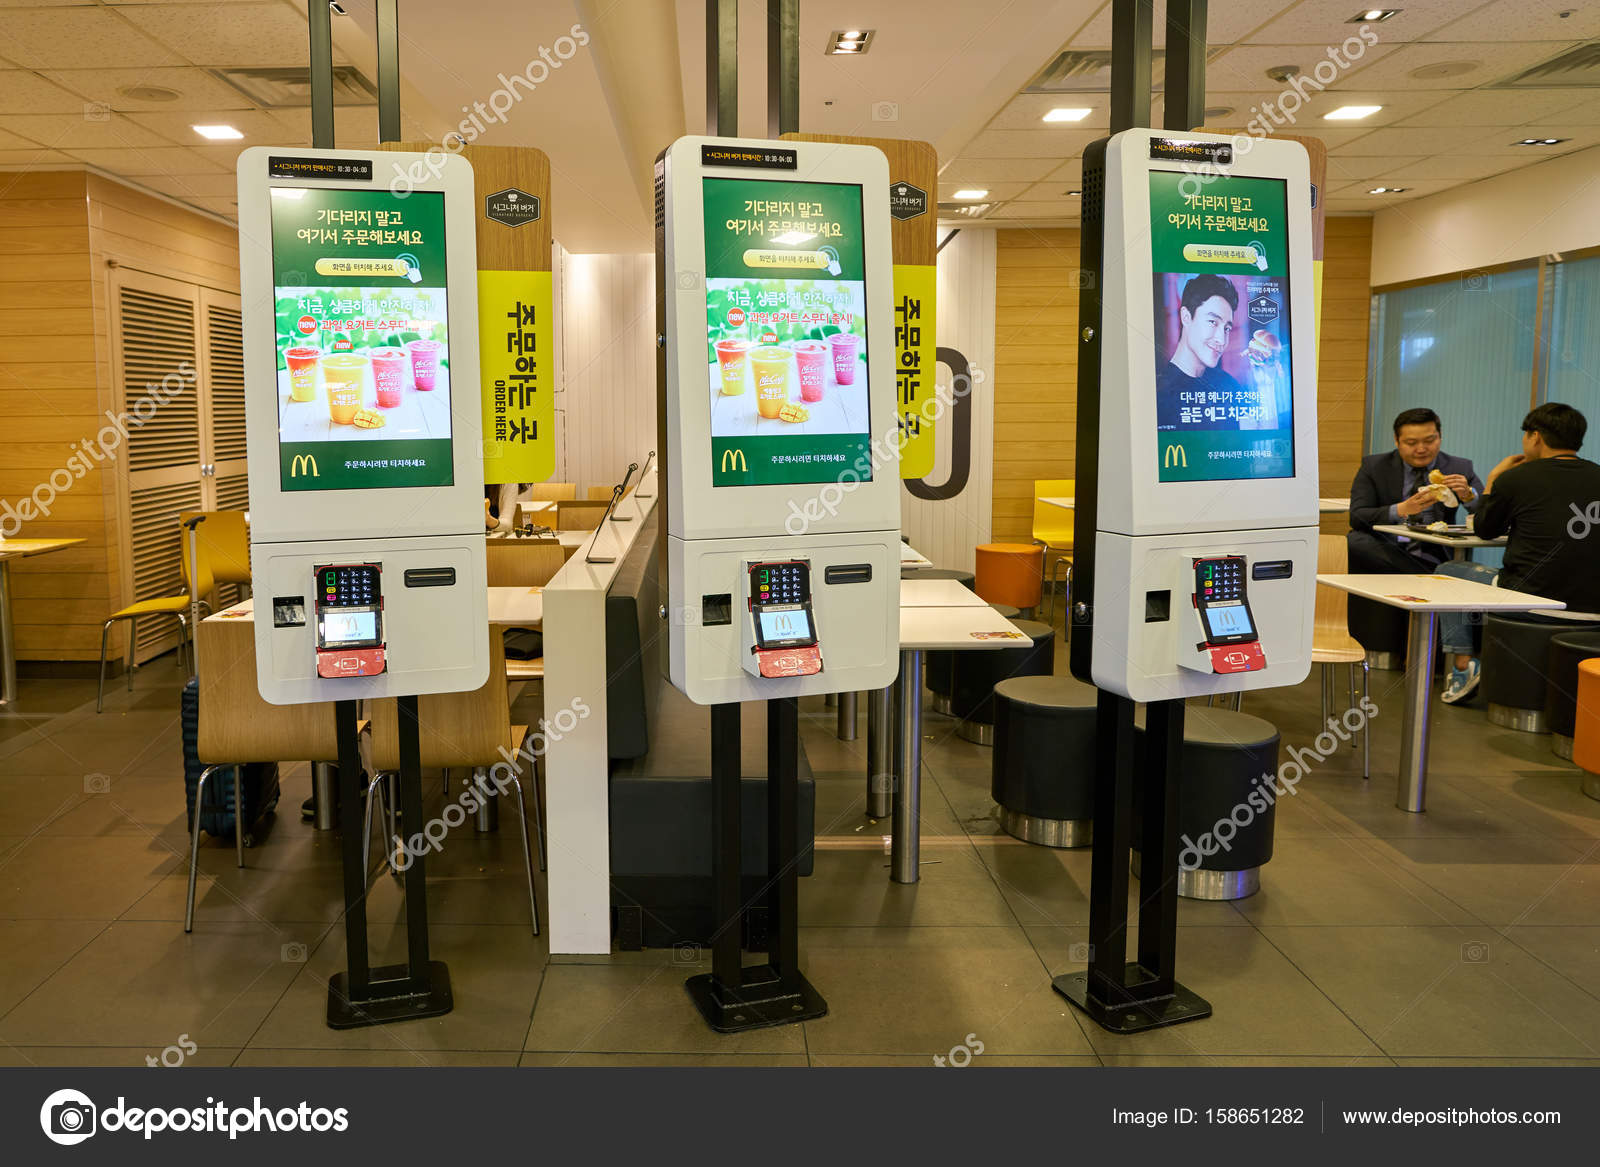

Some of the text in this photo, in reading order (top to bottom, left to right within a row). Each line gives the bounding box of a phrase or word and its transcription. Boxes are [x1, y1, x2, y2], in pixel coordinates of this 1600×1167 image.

[492, 203, 535, 213] 시그니처 버거
[744, 200, 824, 218] 기다리지 말고
[891, 196, 922, 206] 그니처 버거
[1184, 194, 1253, 213] 기다리지 말고
[317, 209, 404, 227] 기다리지 말고
[1168, 213, 1270, 232] 여기서 주문해보세요
[726, 219, 843, 238] 여기서 주문해보세요
[296, 228, 424, 246] 여기서 주문해보세요
[332, 262, 394, 272] 화면을 터치해 주세요
[297, 298, 326, 314] 지금,
[328, 298, 377, 314] 상큼하게
[728, 290, 754, 307] 지금,
[756, 291, 801, 307] 상큼하게
[300, 320, 316, 329] new
[728, 312, 744, 322] new
[749, 312, 853, 324] 과일 요거트 스무디 출시!
[322, 320, 343, 332] 과일
[345, 320, 376, 332] 요거트
[377, 320, 408, 332] 스무디
[895, 296, 920, 404] 주문하는
[507, 302, 538, 444] 주문하는 곳
[1180, 391, 1206, 404] 다니엘
[1208, 391, 1233, 404] 헤니가
[494, 380, 506, 442] ORDER HERE
[1180, 406, 1202, 423] 골든
[1204, 406, 1226, 422] 에그
[771, 454, 846, 464] 주문하시려면 터치하세요
[1208, 450, 1242, 460] 주문하시려면
[344, 459, 426, 468] 주문하시려면 터치하세요
